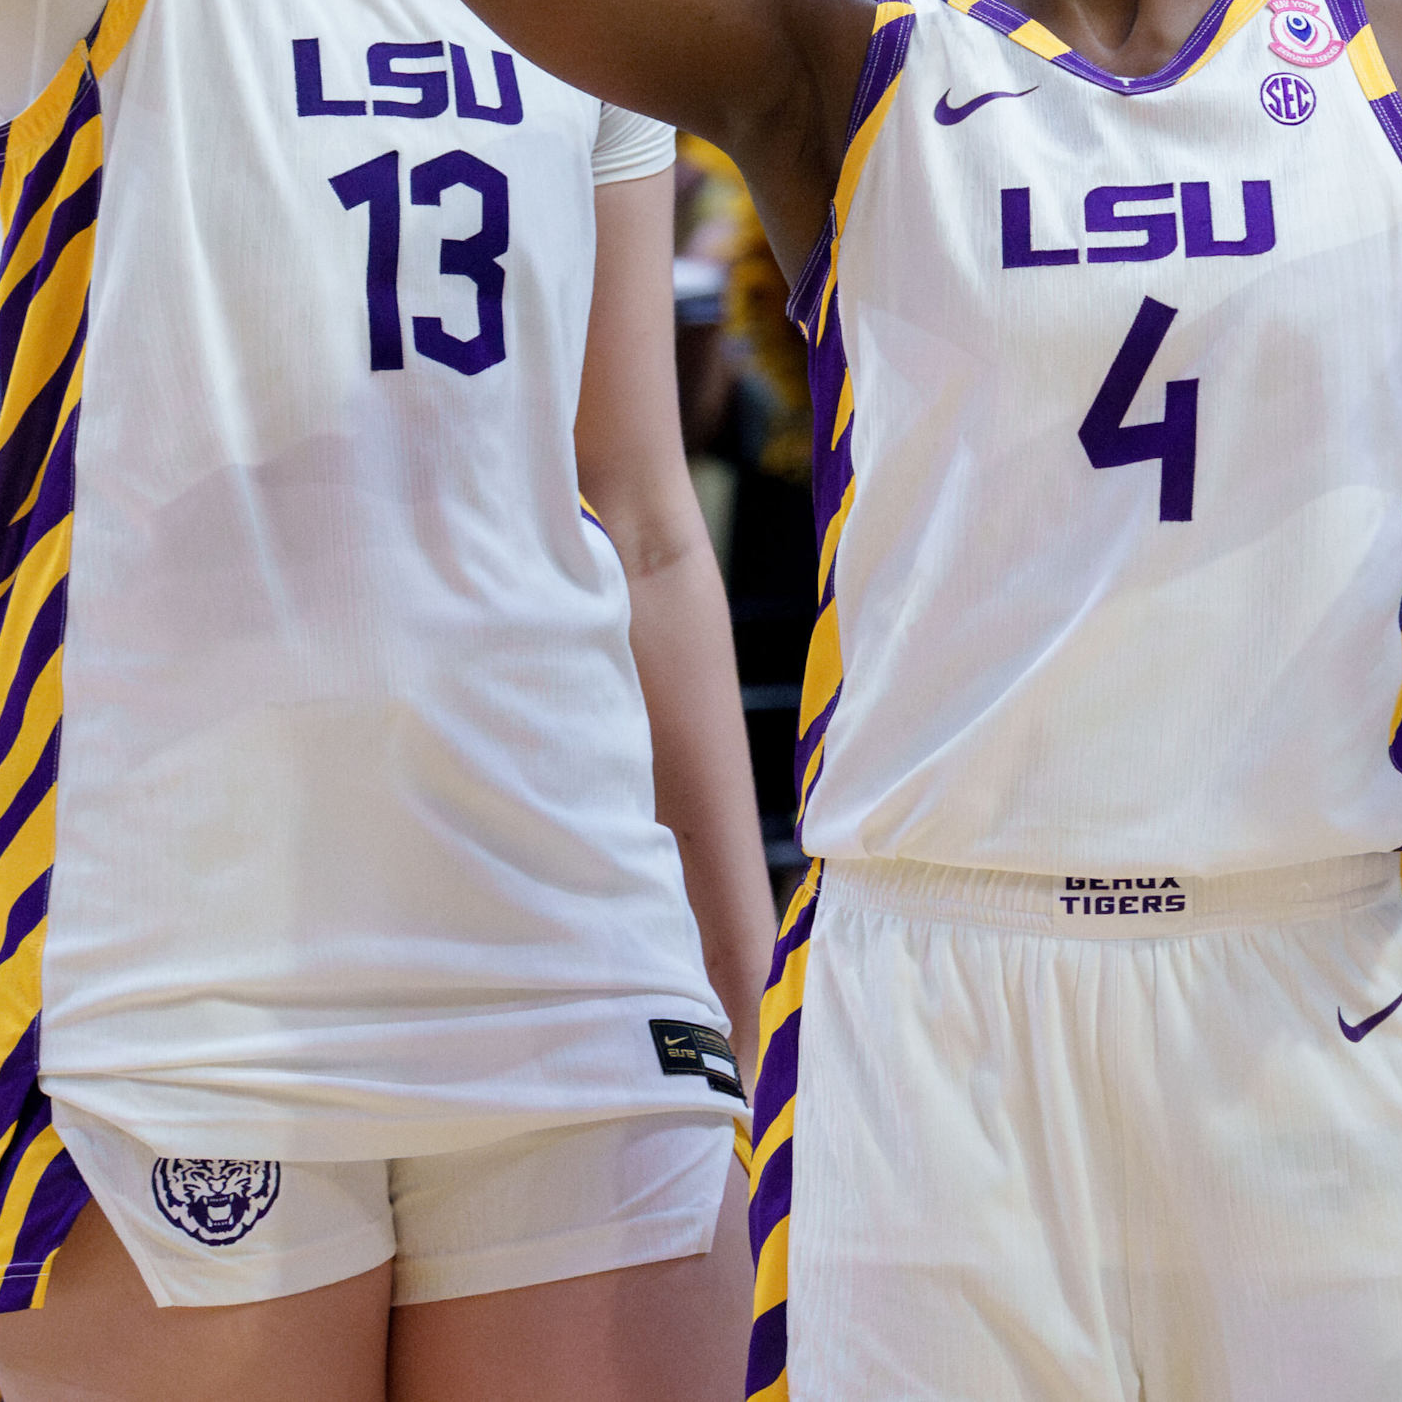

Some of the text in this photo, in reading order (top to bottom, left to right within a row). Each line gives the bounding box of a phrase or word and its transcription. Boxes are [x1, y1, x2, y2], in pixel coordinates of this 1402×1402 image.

[1292, 0, 1316, 12] YOW
[292, 37, 523, 125] LSU
[1266, 77, 1311, 119] SEC
[328, 149, 509, 376] 13
[1001, 180, 1276, 269] LSU
[1078, 295, 1200, 522] 4
[1059, 894, 1186, 915] TIGERS
